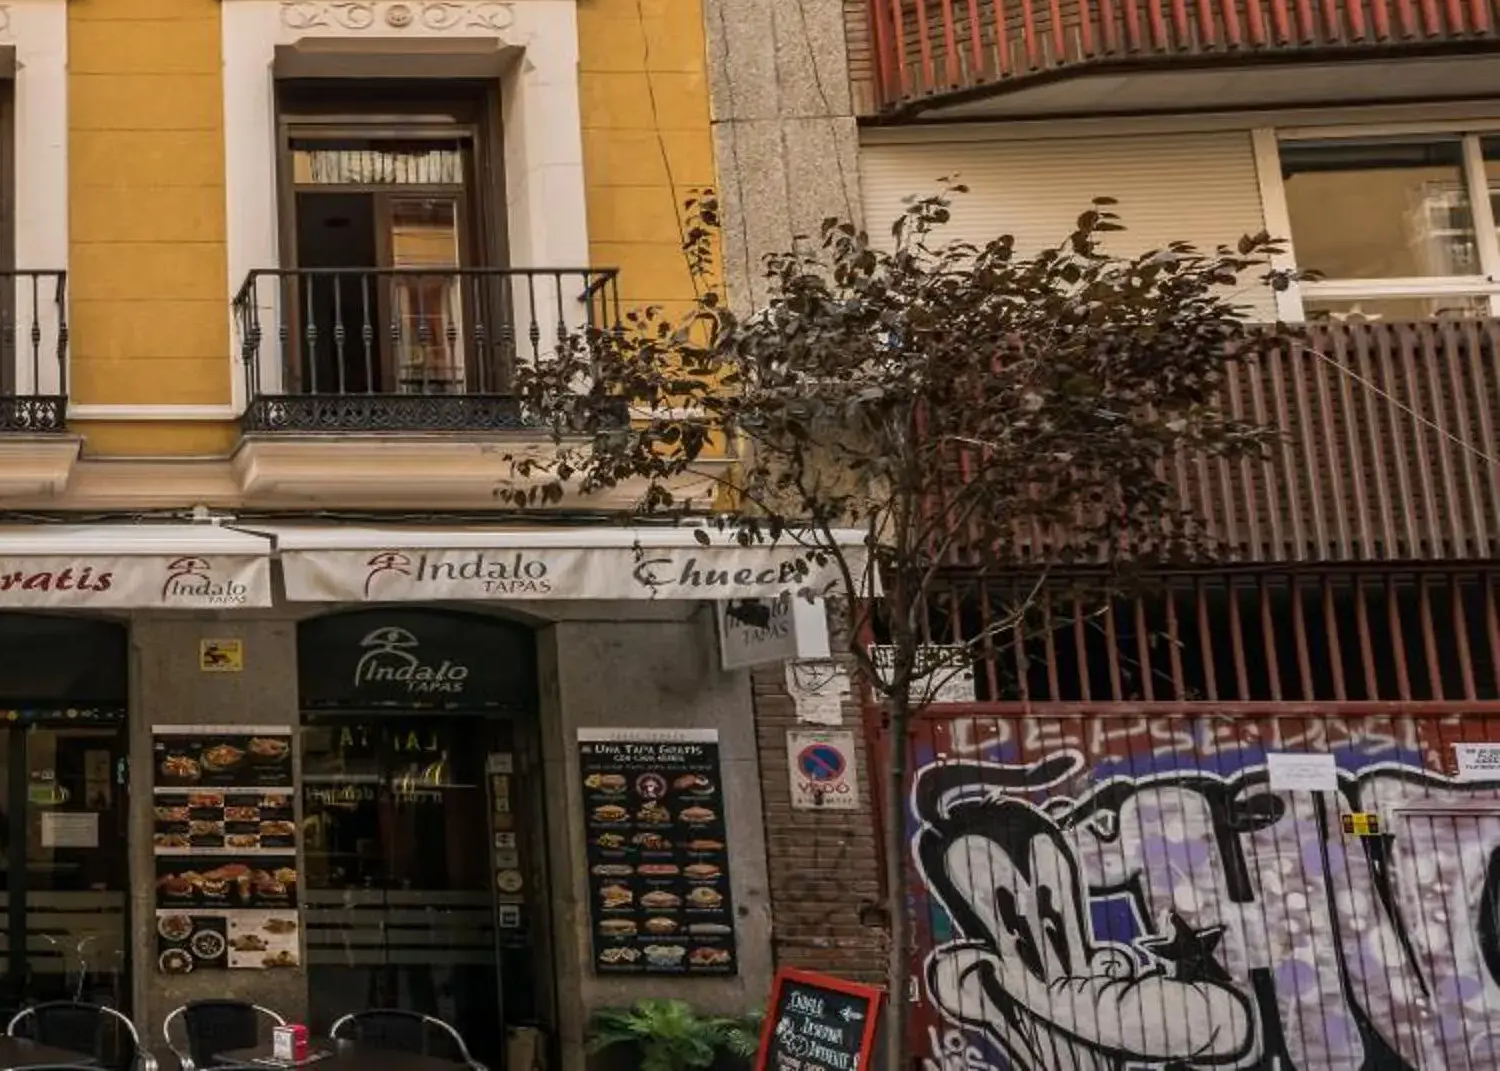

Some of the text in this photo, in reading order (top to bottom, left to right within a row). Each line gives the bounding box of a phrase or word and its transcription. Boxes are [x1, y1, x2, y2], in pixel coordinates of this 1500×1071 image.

[415, 552, 548, 581] Indalo
[172, 579, 247, 596] Indalo
[483, 580, 552, 594] TAPAS
[364, 659, 469, 682] Indalo
[406, 681, 465, 693] TAPAS
